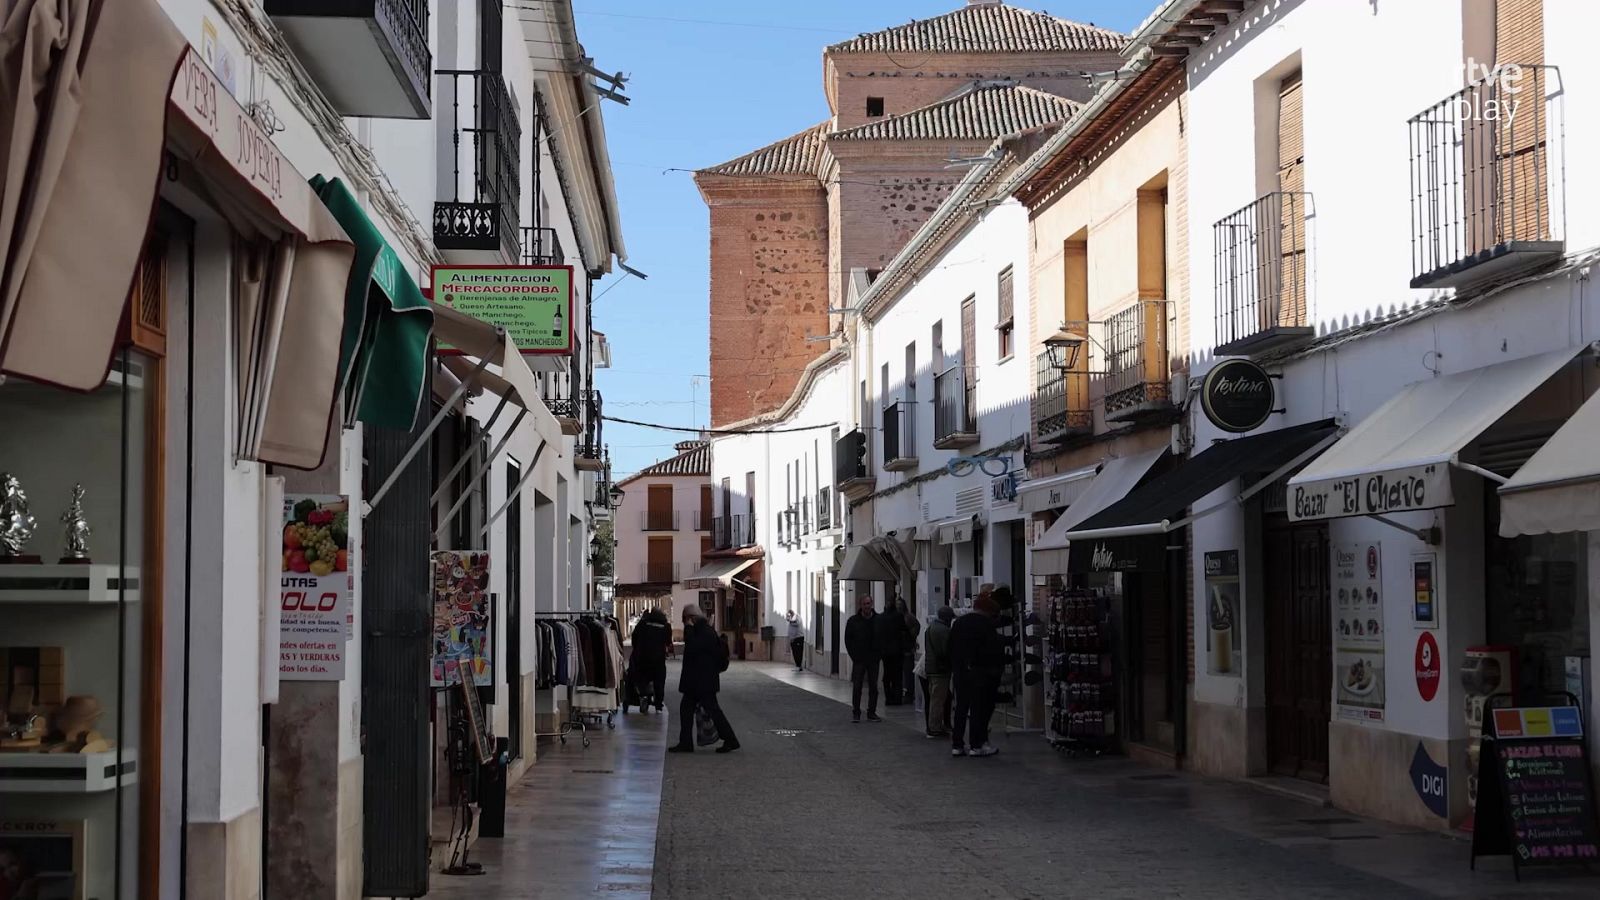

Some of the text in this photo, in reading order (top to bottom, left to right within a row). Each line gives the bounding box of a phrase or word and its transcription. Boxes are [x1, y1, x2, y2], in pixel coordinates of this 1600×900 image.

[182, 46, 282, 200] VERA JOYERIA
[451, 273, 551, 283] ALIMENTACION
[442, 284, 560, 293] MERCACORDOBA
[525, 337, 563, 346] MANCHEGOS
[1295, 486, 1328, 518] Bazar
[299, 641, 326, 649] ofertas
[292, 653, 297, 661] Y
[299, 653, 340, 661] VERDURAS
[297, 664, 309, 672] los
[1422, 774, 1444, 797] DIGI
